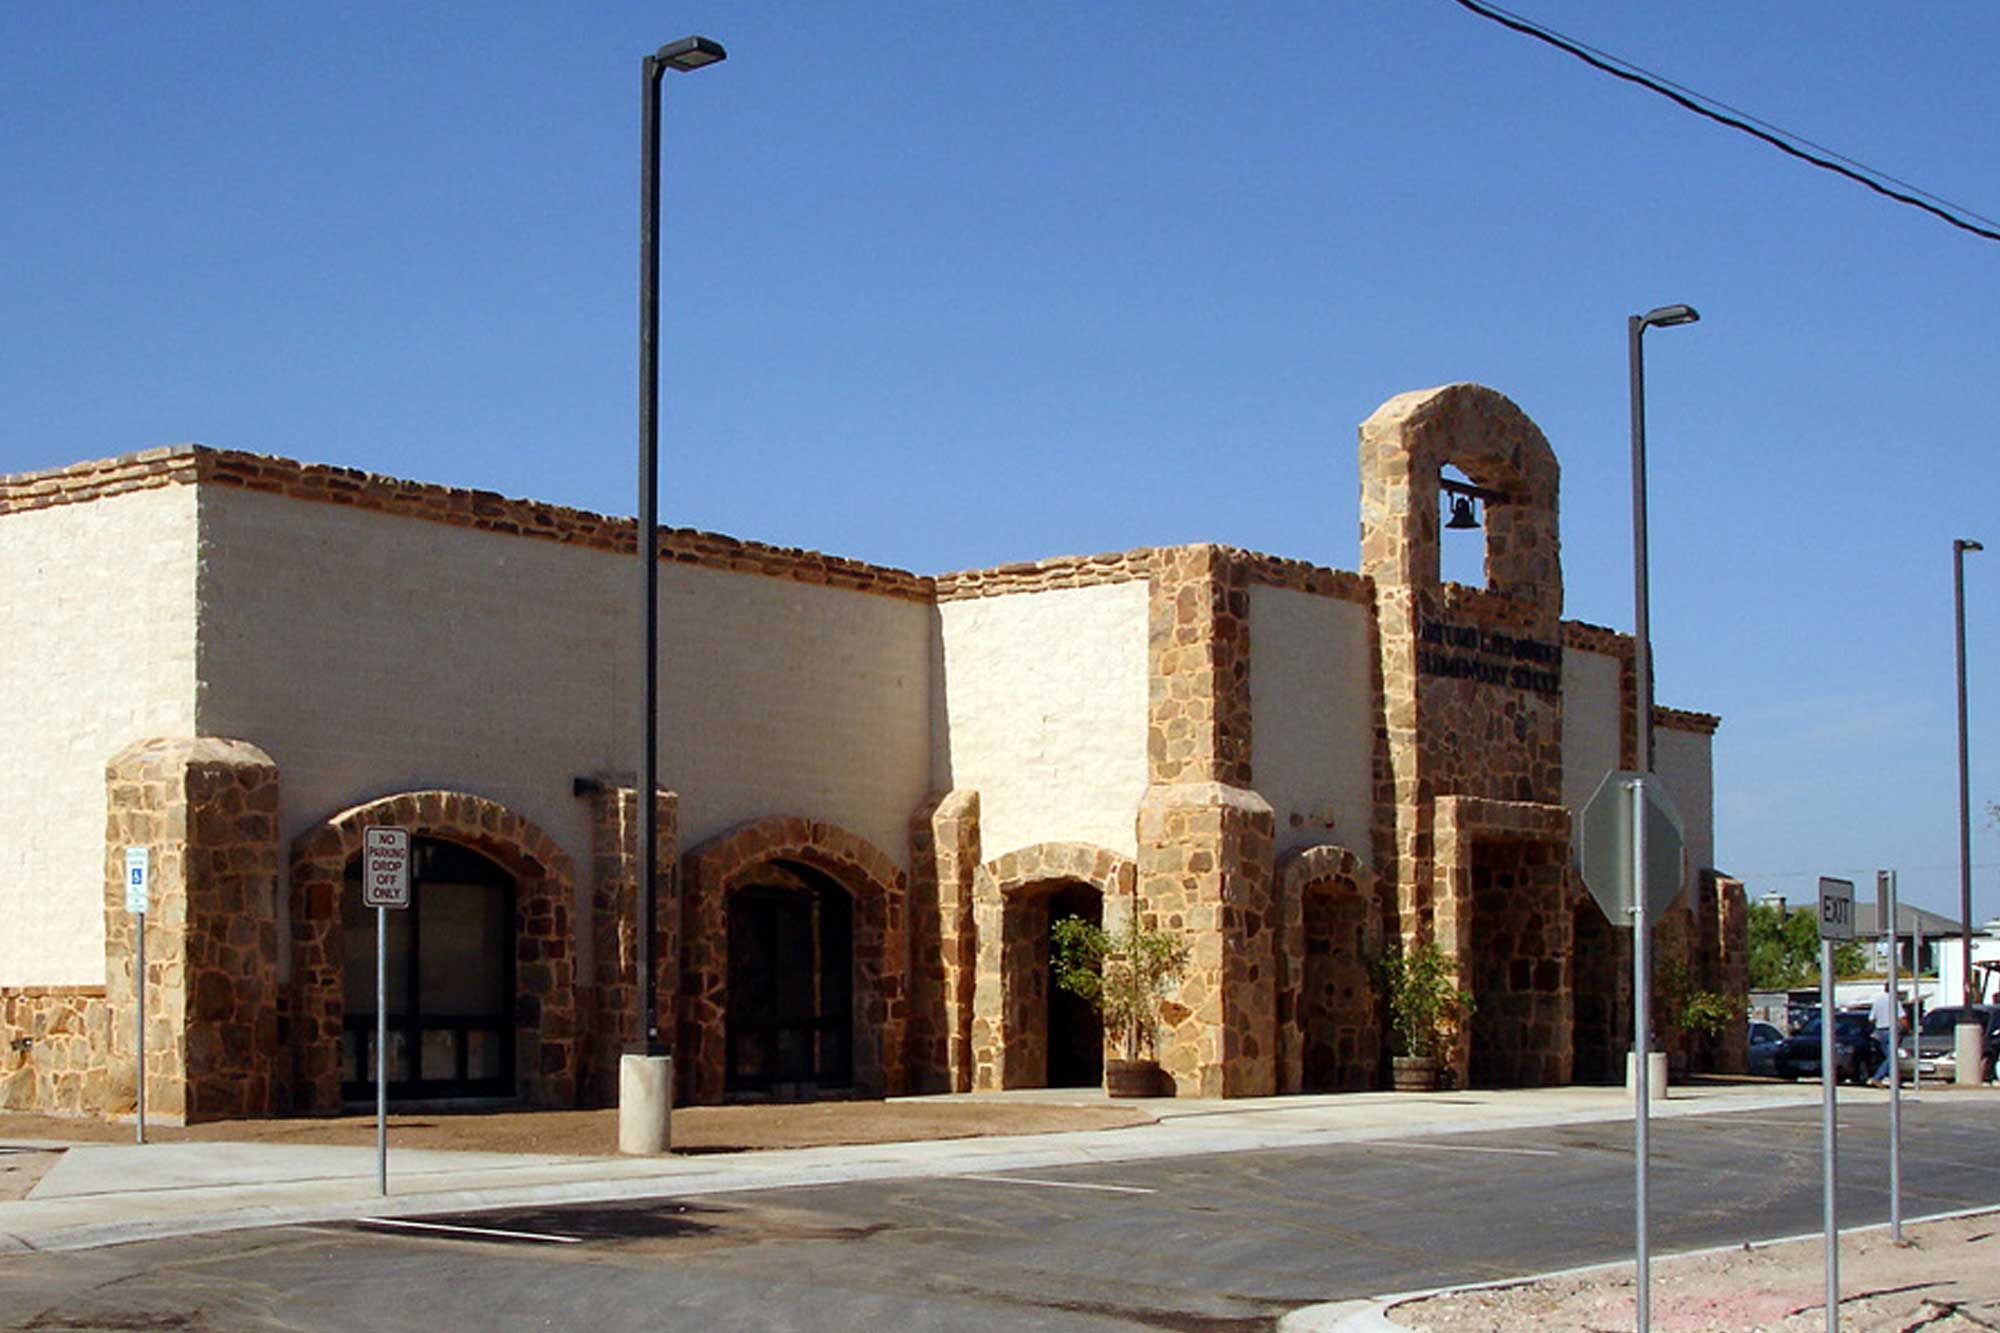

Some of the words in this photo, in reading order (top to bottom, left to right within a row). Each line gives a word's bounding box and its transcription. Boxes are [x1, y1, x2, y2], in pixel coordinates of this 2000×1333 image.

[379, 834, 395, 845] NO
[370, 847, 404, 859] PARKING
[372, 860, 401, 871] DROP
[376, 873, 398, 885] OFF
[374, 887, 400, 899] ONLY
[1824, 895, 1849, 924] EXIT
